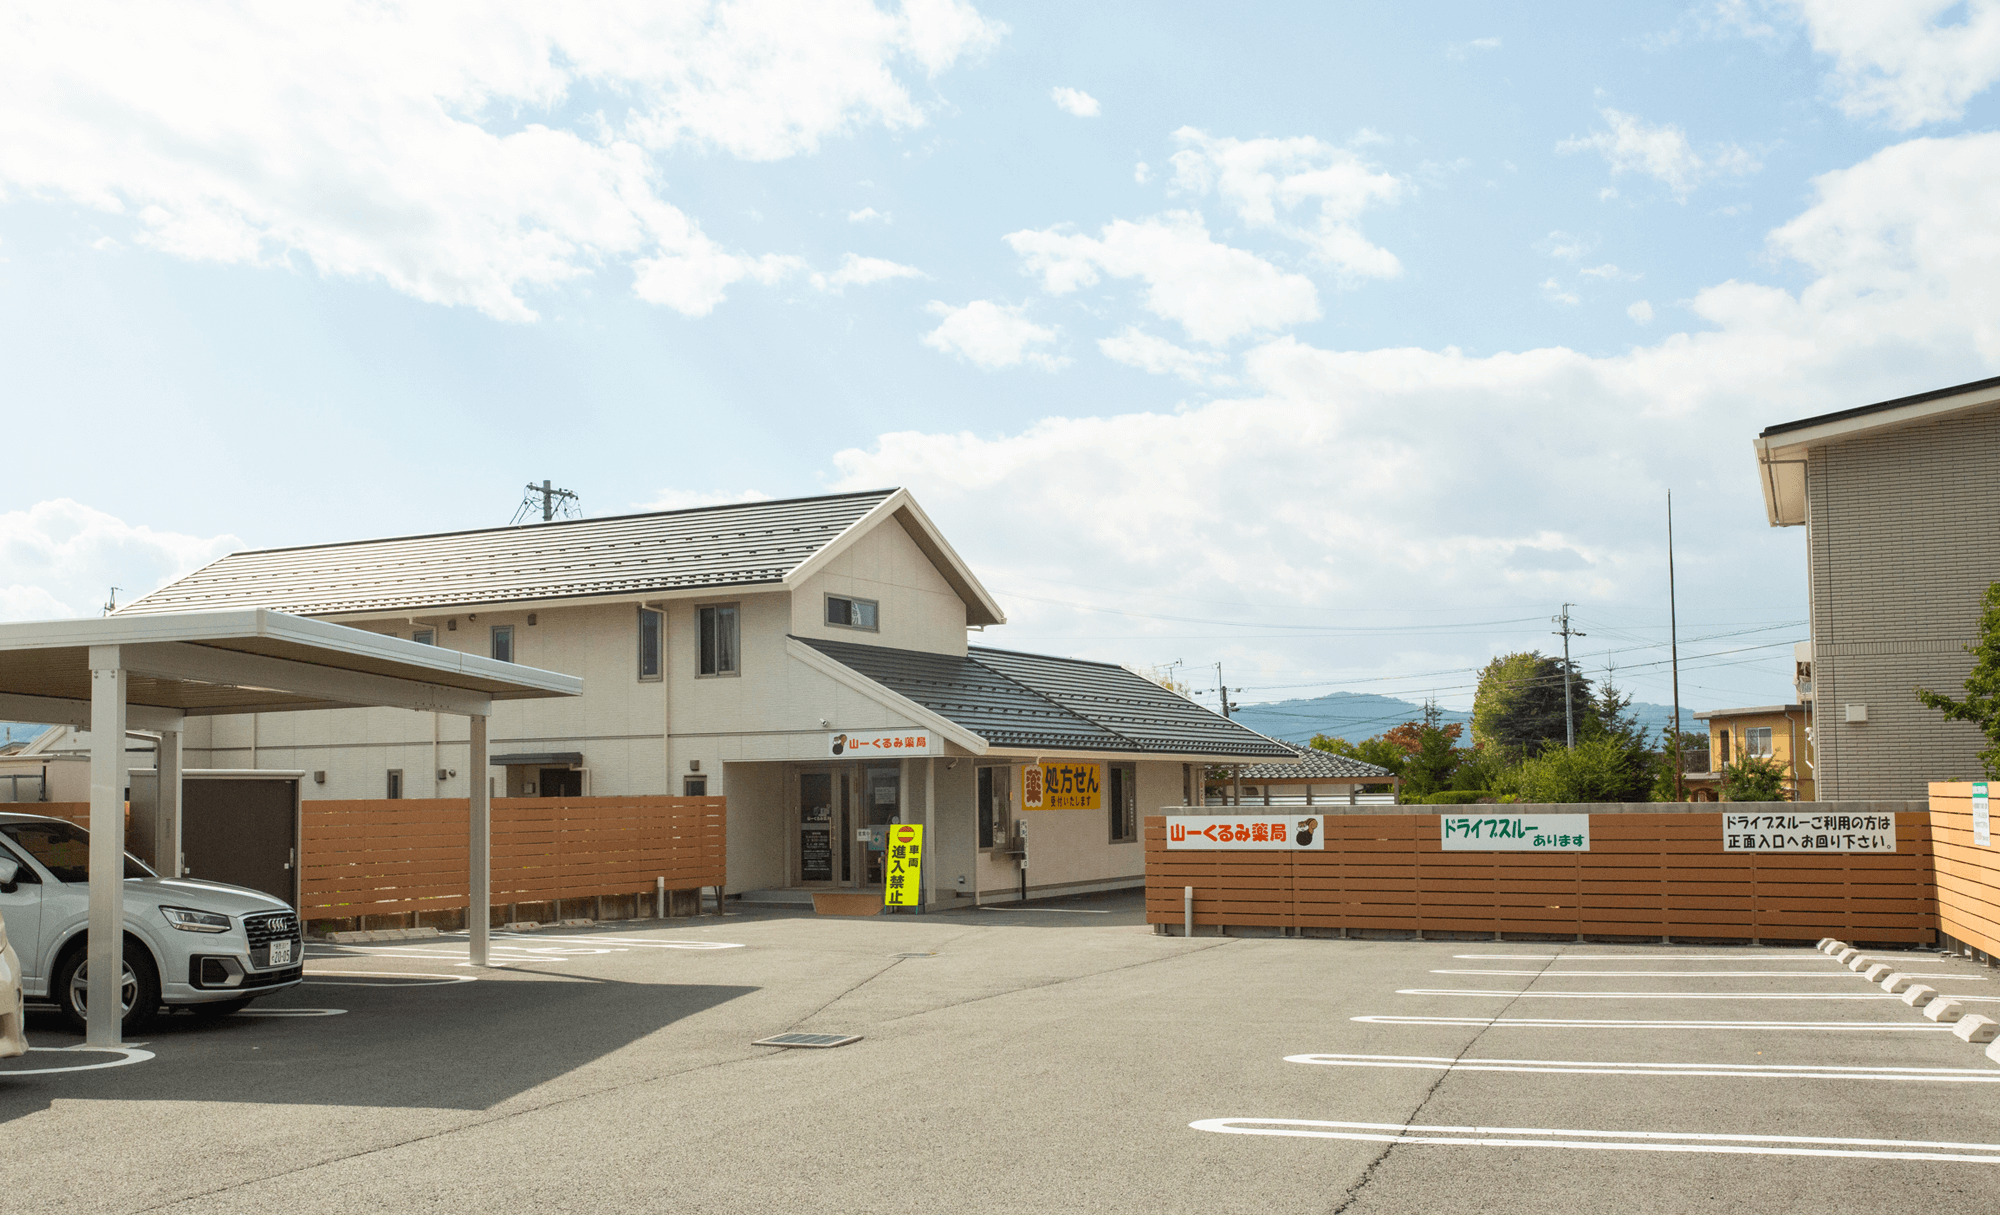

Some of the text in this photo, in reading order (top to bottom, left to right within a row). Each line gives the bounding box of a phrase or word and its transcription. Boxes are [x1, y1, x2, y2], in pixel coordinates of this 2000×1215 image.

[849, 737, 926, 749] 山一くるみ薬局
[1026, 769, 1042, 803] 薬
[1045, 765, 1099, 794] 処方せん
[1051, 795, 1091, 807] 受付いたします
[1445, 818, 1538, 838] ドライブスルー
[1727, 815, 1890, 830] ドライブスルーご利用の方は
[1170, 823, 1287, 842] 山一くるみ薬局
[1533, 834, 1585, 847] あります
[1728, 834, 1891, 850] 正面入口へお回り下さい。
[908, 844, 919, 868] 車両
[888, 844, 906, 905] 進入禁止
